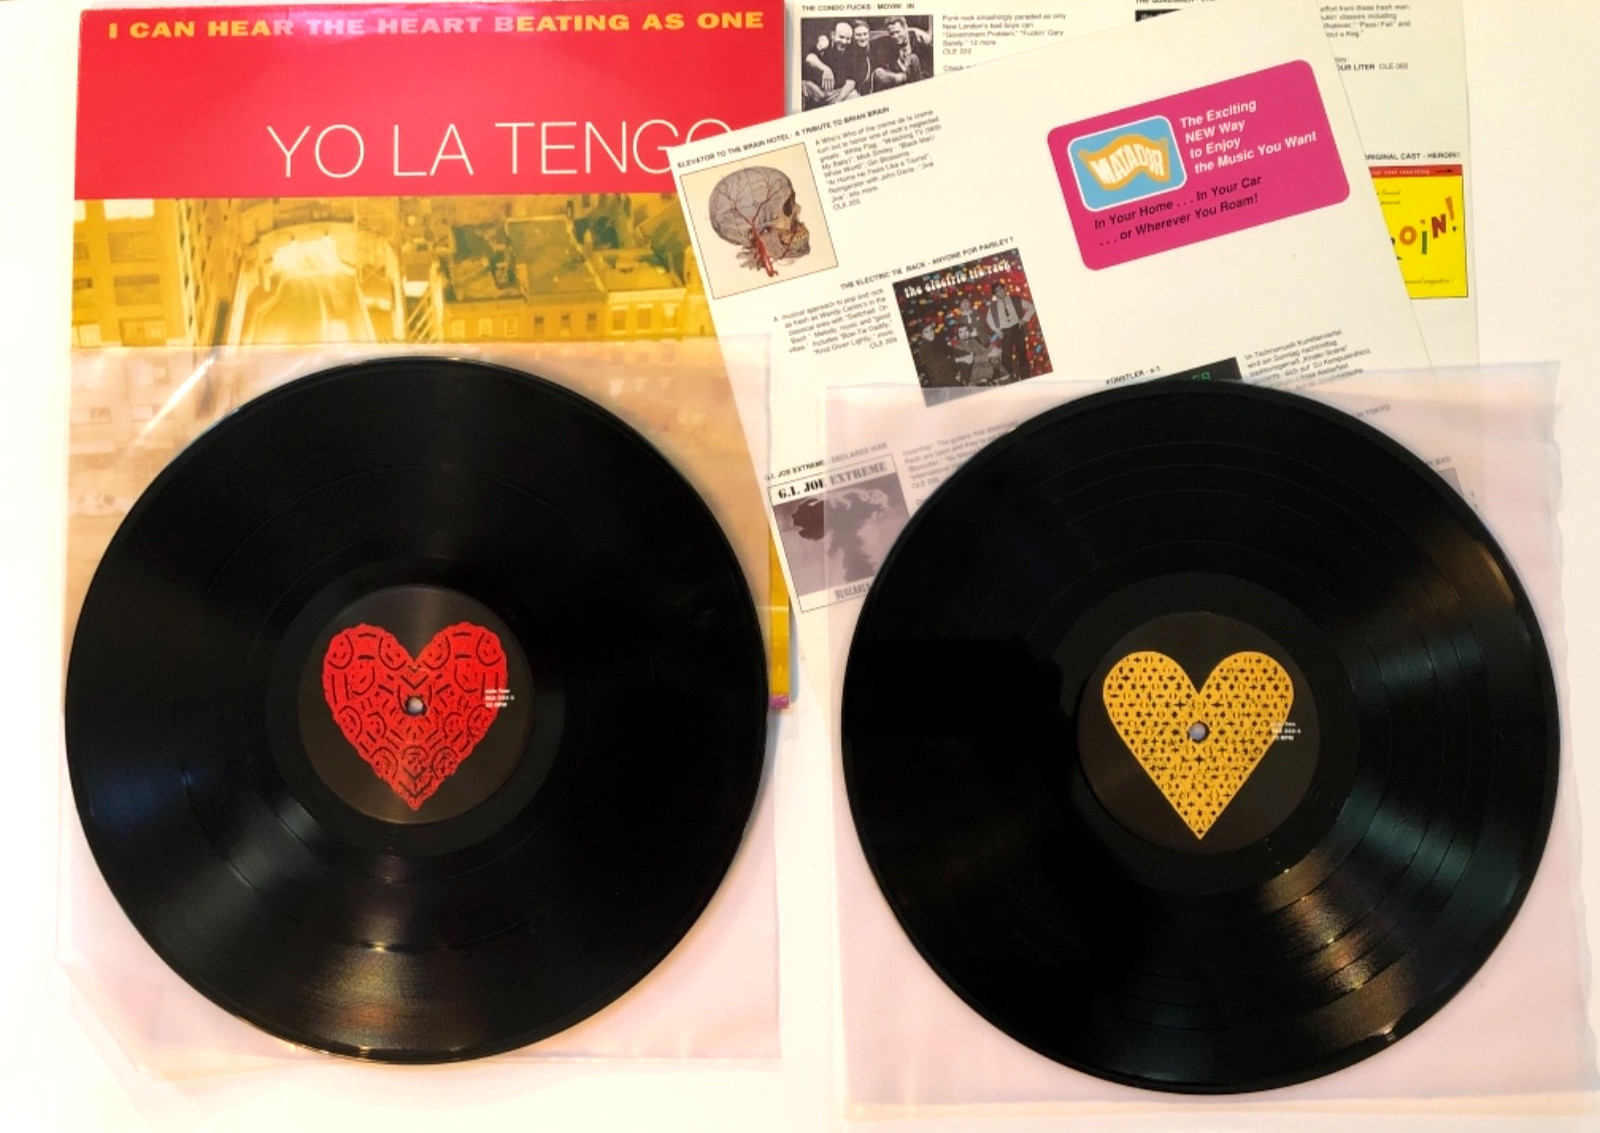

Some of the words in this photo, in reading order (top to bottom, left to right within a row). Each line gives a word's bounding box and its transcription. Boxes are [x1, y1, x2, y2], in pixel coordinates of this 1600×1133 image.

[109, 23, 118, 39] I
[129, 21, 195, 39] CAN
[208, 18, 294, 38] HEAR
[306, 17, 366, 36] THE
[378, 16, 480, 34] HEART
[495, 12, 630, 33] BEATING
[642, 12, 686, 31] AS
[697, 11, 764, 29] ONE
[1180, 116, 1203, 128] The
[1206, 101, 1256, 121] Exciting
[1185, 126, 1215, 143] NEW
[1219, 120, 1245, 133] Way
[267, 123, 364, 180] YO
[394, 122, 474, 178] LA
[677, 153, 715, 168] ELEVATOR
[743, 141, 765, 150] BRAIN
[802, 122, 831, 134] TRIBUTE
[844, 113, 866, 123] BRIAN
[867, 107, 889, 117] BRAIN
[1190, 148, 1202, 159] to
[1206, 138, 1240, 154] Enjoy
[1195, 161, 1214, 174] the
[1217, 150, 1254, 167] Music
[1258, 143, 1281, 155] You
[1285, 131, 1316, 148] Want
[1089, 145, 1166, 185] MATADOR
[1095, 219, 1105, 229] In
[1109, 211, 1136, 225] Your
[1139, 201, 1173, 216] Home
[1196, 191, 1207, 201] In
[1211, 183, 1238, 196] Your
[1241, 176, 1261, 189] Car
[1120, 230, 1132, 240] or
[1136, 214, 1190, 235] Wherever
[1195, 207, 1216, 218] You
[1220, 193, 1257, 212] Roam!
[856, 272, 889, 285] ELECTRIC
[933, 252, 960, 264] ANYONE
[963, 247, 978, 256] FOR
[778, 486, 801, 499] G.I.
[803, 478, 825, 493] JOE
[829, 461, 888, 486] EXTREME
[791, 459, 825, 475] EXTREME
